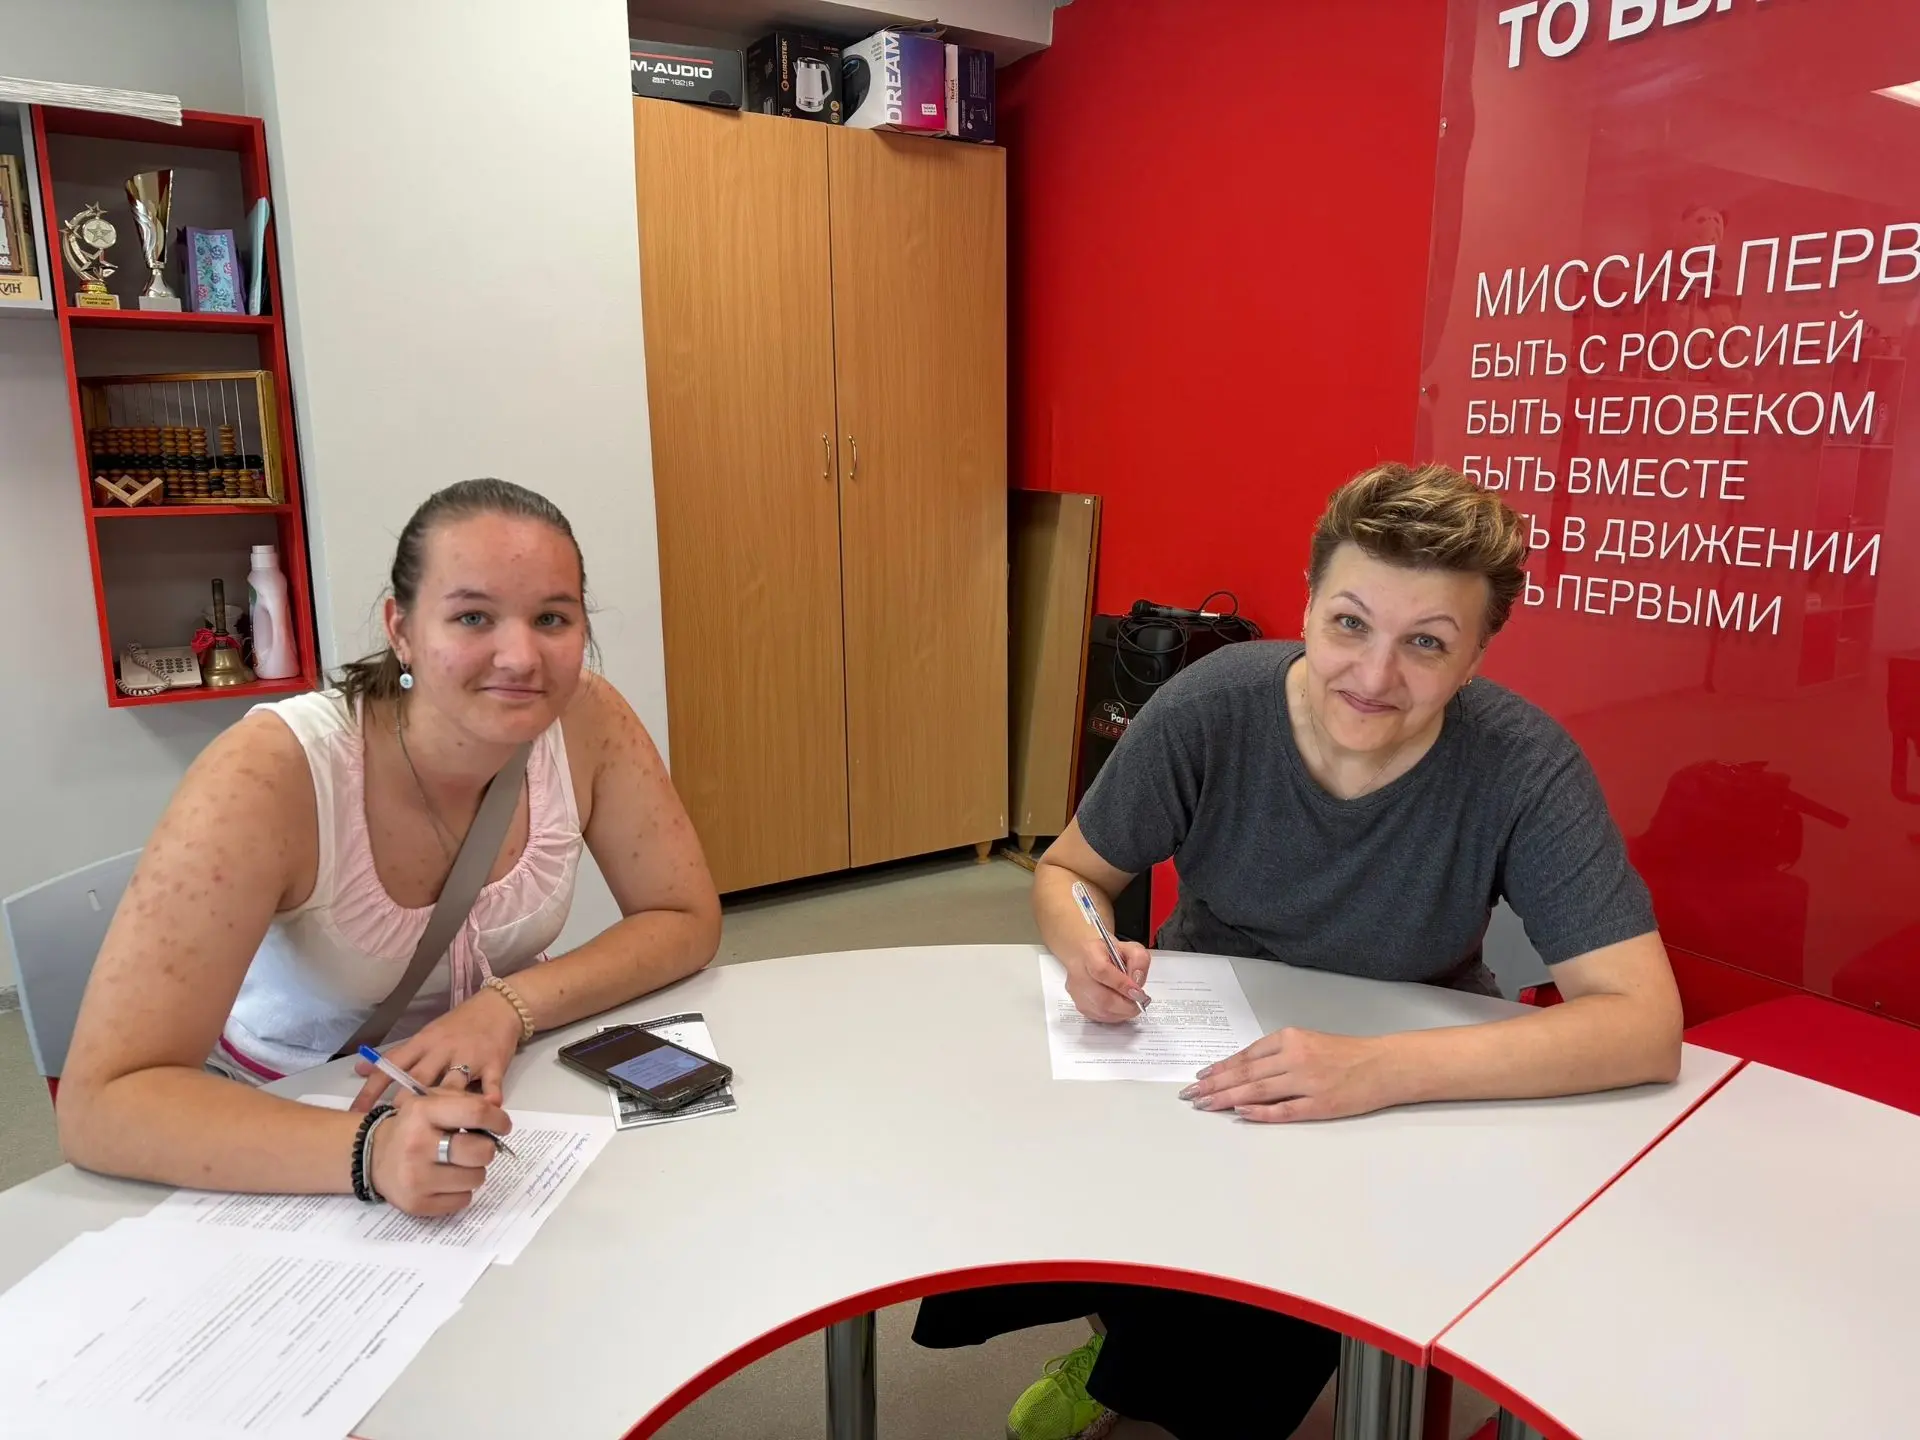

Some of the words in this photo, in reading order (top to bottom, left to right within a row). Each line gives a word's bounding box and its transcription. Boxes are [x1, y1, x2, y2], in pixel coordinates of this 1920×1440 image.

[1498, 0, 1589, 68] ТО
[631, 60, 713, 79] M-AUDIO
[885, 32, 902, 124] DREAM
[1475, 244, 1716, 318] МИССИЯ
[1470, 338, 1567, 379] БЫТЬ
[1579, 335, 1607, 375] С
[1619, 309, 1864, 372] РОССИЕЙ
[1466, 398, 1562, 435] БЫТЬ
[1573, 390, 1876, 436] ЧЕЛОВЕКОМ
[1462, 455, 1556, 493] БЫТЬ
[1567, 457, 1748, 500] ВМЕСТЕ
[1562, 516, 1586, 552] В
[1595, 519, 1881, 577] ДВИЖЕНИИ
[1556, 574, 1782, 635] ПЕРВЫМИ
